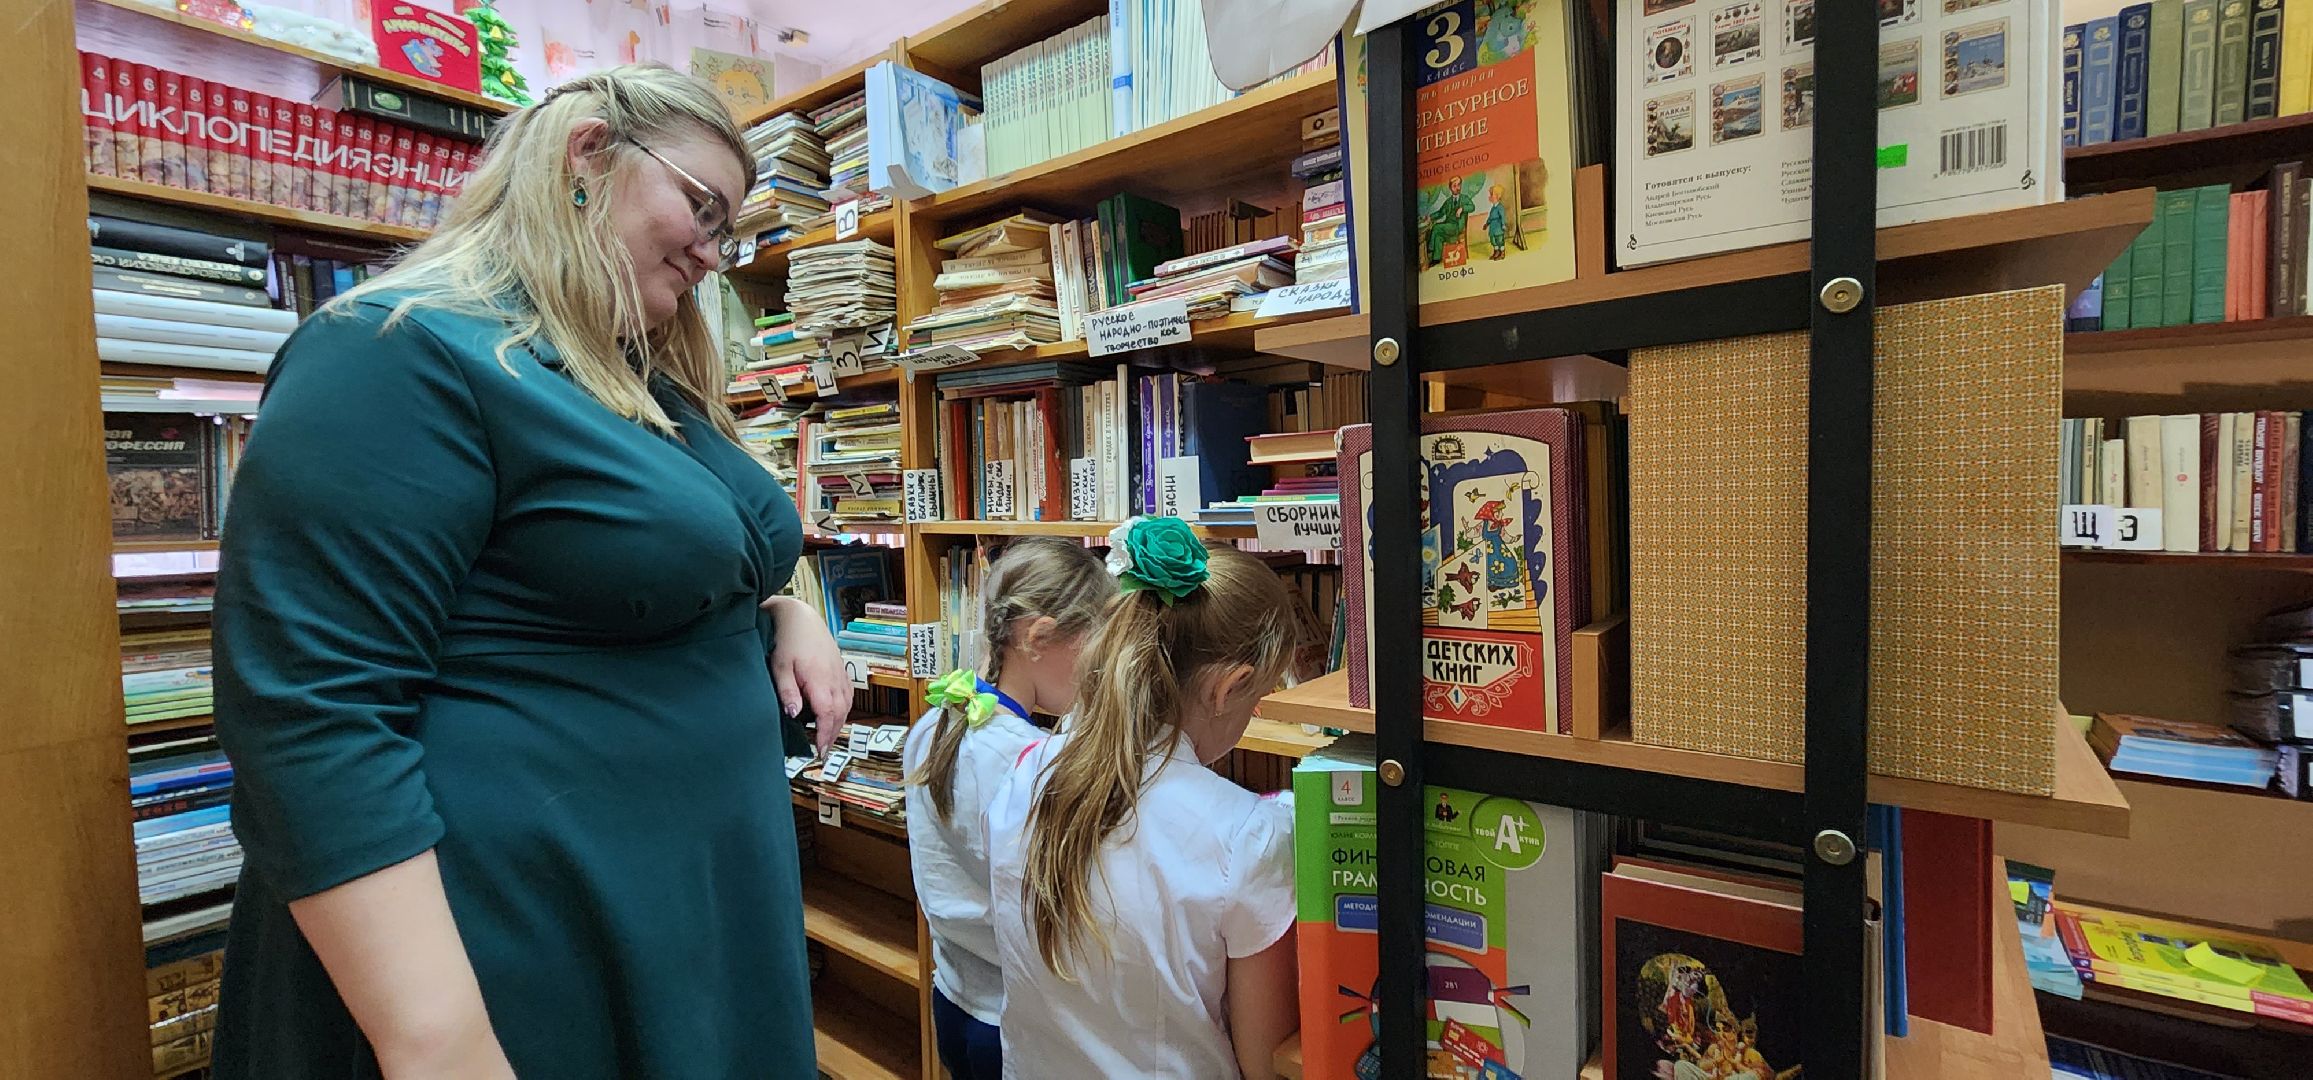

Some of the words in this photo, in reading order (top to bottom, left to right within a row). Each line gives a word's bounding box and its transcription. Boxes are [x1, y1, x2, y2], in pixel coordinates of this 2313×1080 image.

[1425, 11, 1465, 68] 3
[93, 67, 105, 80] 4
[119, 73, 131, 87] 5
[1426, 62, 1465, 83] класс
[143, 78, 156, 91] 6
[1444, 69, 1494, 93] вторая
[166, 83, 178, 96] 7
[190, 88, 202, 102] 8
[213, 94, 224, 107] 9
[232, 99, 249, 113] 10
[256, 105, 269, 118] 11
[276, 108, 291, 123] 12
[298, 114, 313, 128] 13
[318, 119, 333, 132] 14
[340, 125, 354, 138] 15
[358, 128, 372, 141] 16
[378, 133, 391, 145] 17
[398, 138, 410, 150] 18
[418, 142, 430, 154] 19
[434, 146, 450, 159] 20
[452, 151, 465, 162] 21
[1452, 152, 1490, 170] СЛОВО
[1645, 175, 1694, 191] Готовятся
[1705, 164, 1752, 180] выпуску:
[838, 209, 856, 235] В
[1438, 266, 1475, 281] дрофа
[1278, 279, 1340, 298] СКАЗКИ
[1092, 311, 1135, 331] РУССКОЕ
[817, 373, 834, 389] Е
[761, 378, 782, 401] Д
[1072, 472, 1081, 516] СКАЗКИ
[1082, 468, 1090, 514] РУССКИХ
[1165, 475, 1178, 516] БАСНИ
[907, 483, 917, 521] СКАЗКИ
[1267, 506, 1340, 523] СБОРНИК
[2072, 511, 2099, 543] Щ
[1427, 640, 1516, 666] ДЕТСКИХ
[1431, 662, 1483, 684] КНИГ
[1453, 689, 1460, 703] 1
[1341, 779, 1351, 795] 4
[820, 802, 839, 818] Ч
